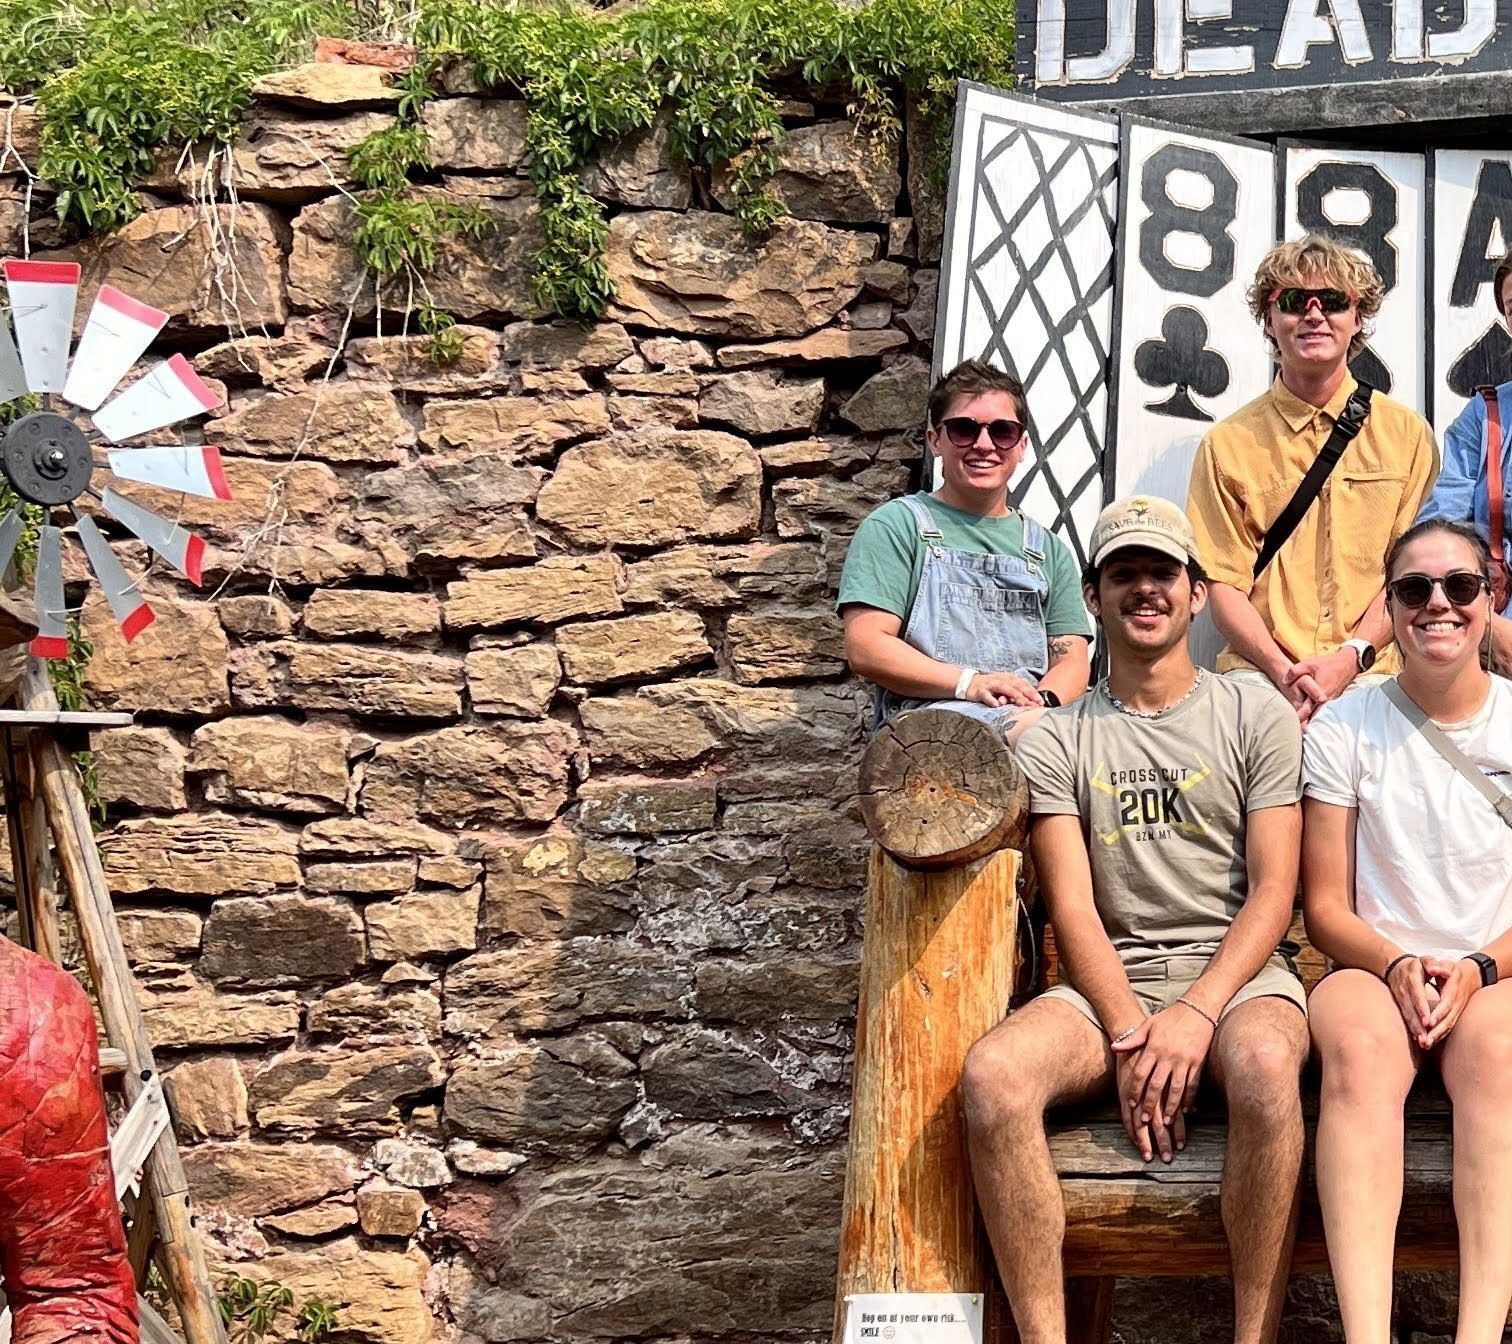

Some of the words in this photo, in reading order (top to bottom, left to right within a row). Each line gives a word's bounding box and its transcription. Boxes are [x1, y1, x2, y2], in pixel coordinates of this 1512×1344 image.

[1139, 141, 1241, 299] 8
[1120, 788, 1182, 825] 20K
[900, 1314, 919, 1325] your
[921, 1314, 939, 1323] own
